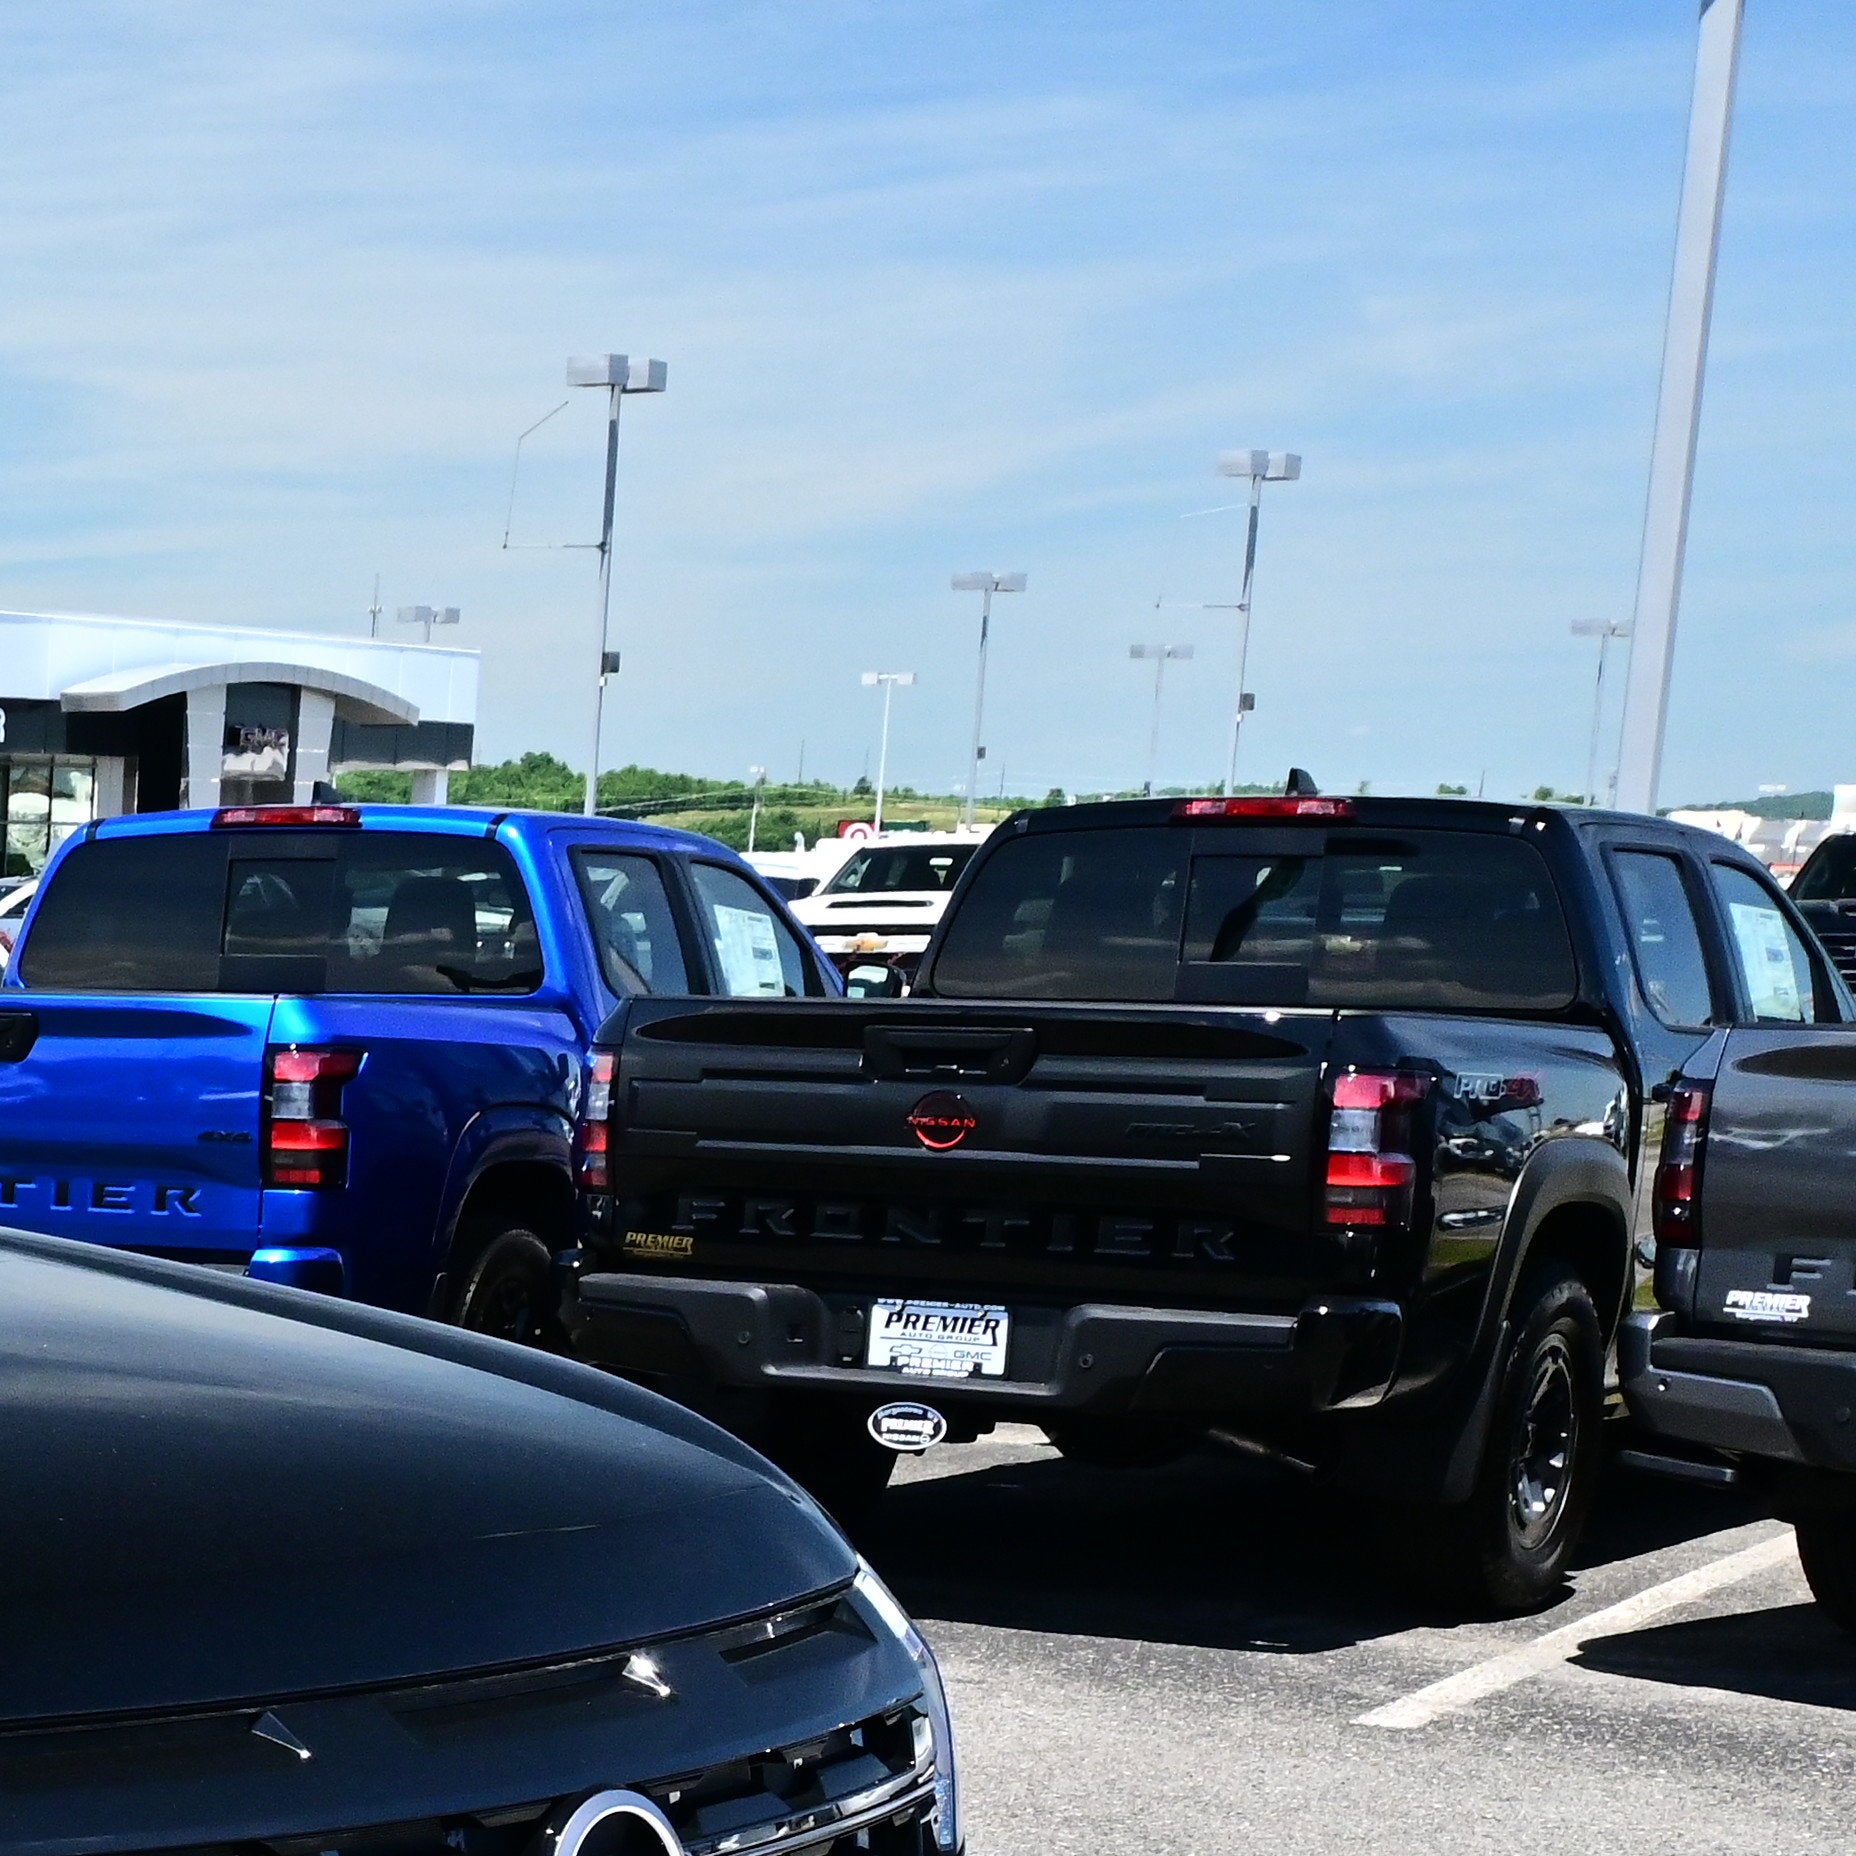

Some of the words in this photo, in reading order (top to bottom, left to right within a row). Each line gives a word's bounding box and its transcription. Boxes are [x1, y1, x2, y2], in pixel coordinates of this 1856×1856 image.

[907, 1116, 976, 1128] NISSAN
[672, 1196, 1236, 1260] FRONTIER
[625, 1231, 694, 1254] PREMIER
[1726, 1290, 1811, 1317] PREMIER
[885, 1312, 1001, 1346] PREMIER
[900, 1331, 933, 1340] AUTO
[937, 1334, 980, 1342] GROUP
[897, 1356, 975, 1371] PREMIER
[953, 1350, 993, 1361] GMC
